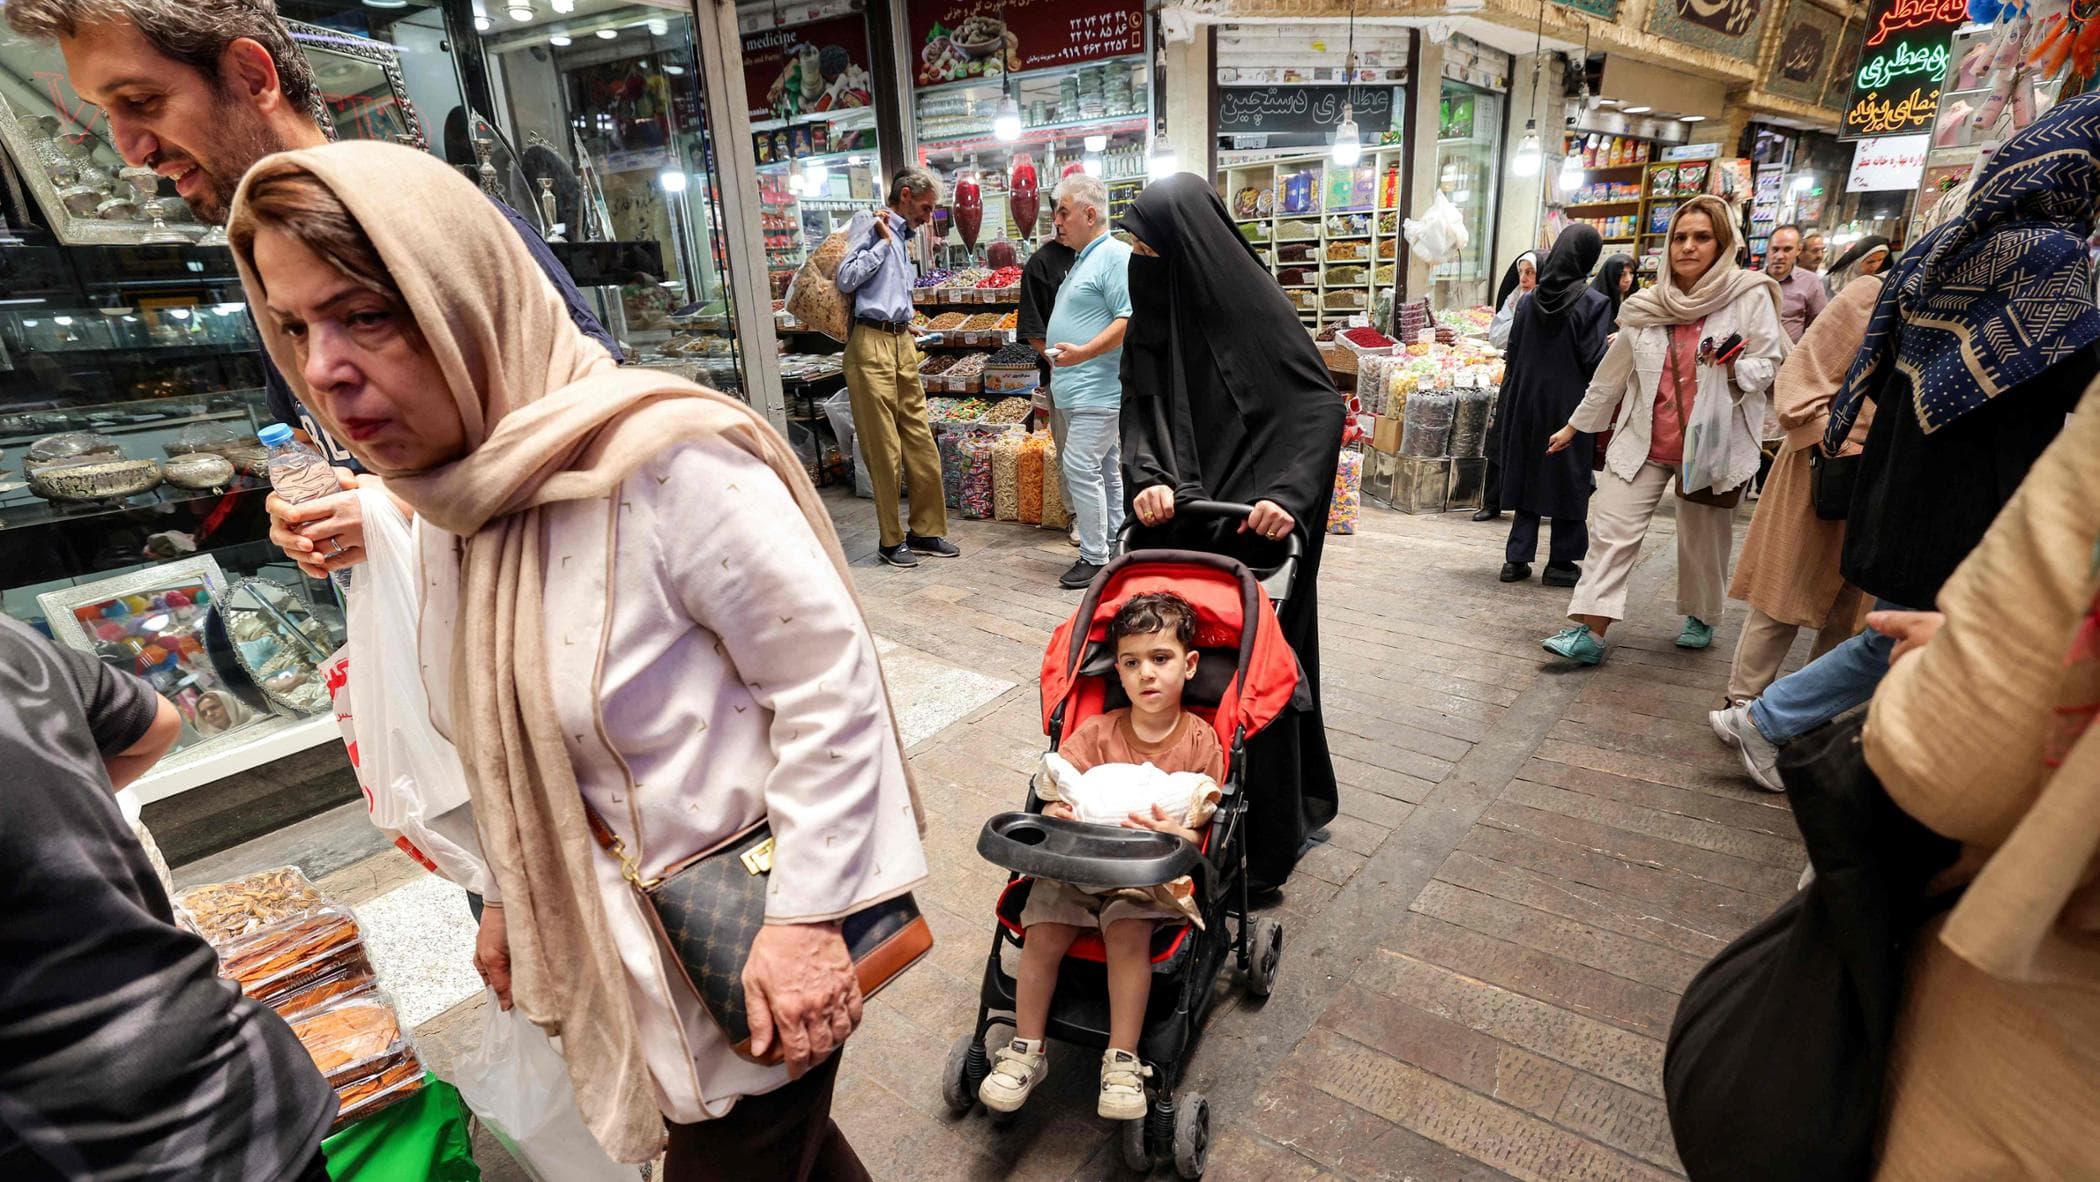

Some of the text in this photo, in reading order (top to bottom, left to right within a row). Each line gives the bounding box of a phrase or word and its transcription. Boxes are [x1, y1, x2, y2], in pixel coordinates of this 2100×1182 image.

[1085, 15, 1097, 28] ۷۴
[1099, 12, 1112, 25] ۷۴
[746, 31, 797, 51] medicine
[1099, 26, 1112, 38] ۸۵
[1220, 86, 1389, 127] عطاری دستچین
